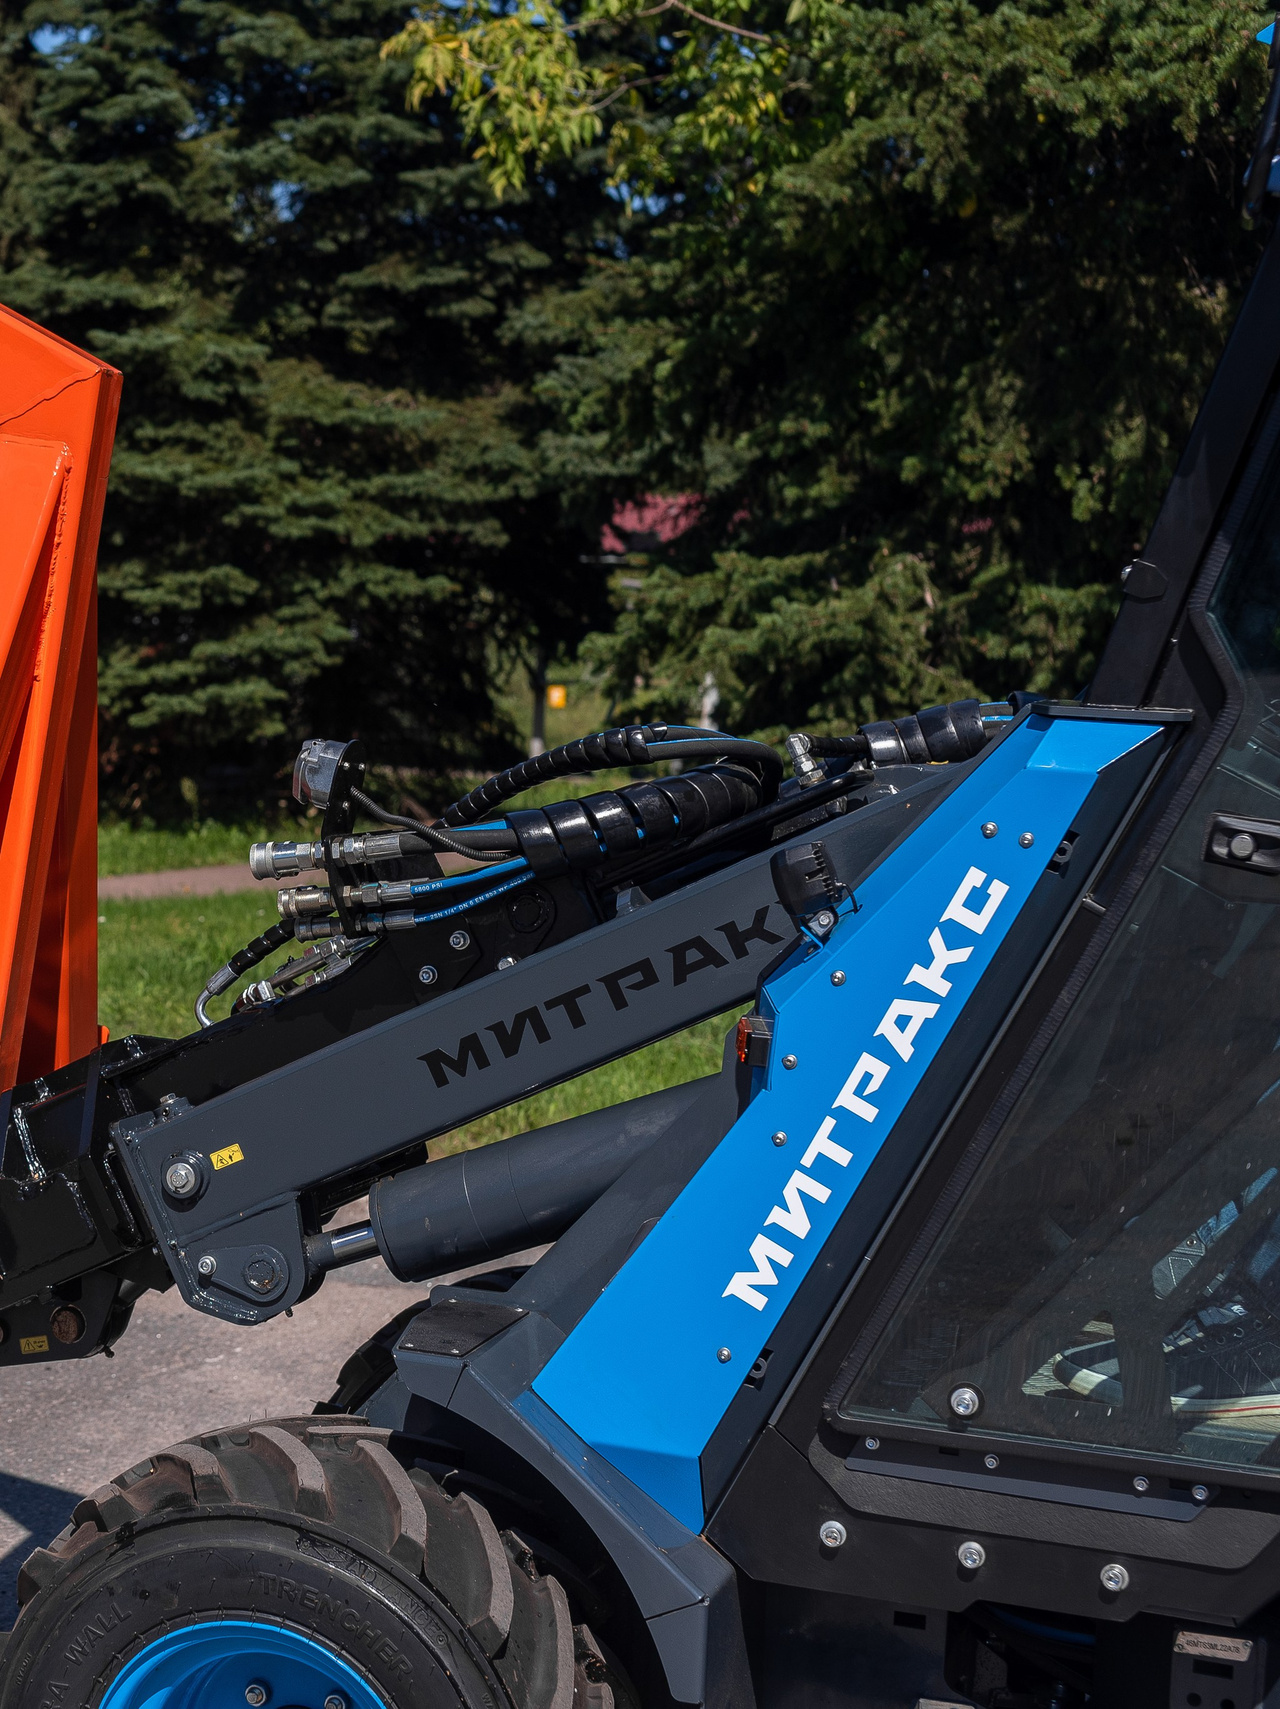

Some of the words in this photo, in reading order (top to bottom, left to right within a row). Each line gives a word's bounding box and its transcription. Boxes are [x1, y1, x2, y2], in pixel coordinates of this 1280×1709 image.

[432, 882, 443, 891] PSI
[475, 896, 484, 904] EN
[416, 898, 784, 1088] МИТРАК
[721, 866, 1009, 1311] МИТРАКС
[64, 1602, 133, 1667] WALL
[258, 1571, 414, 1682] TRENCHER
[346, 1560, 439, 1638] ADVANCE
